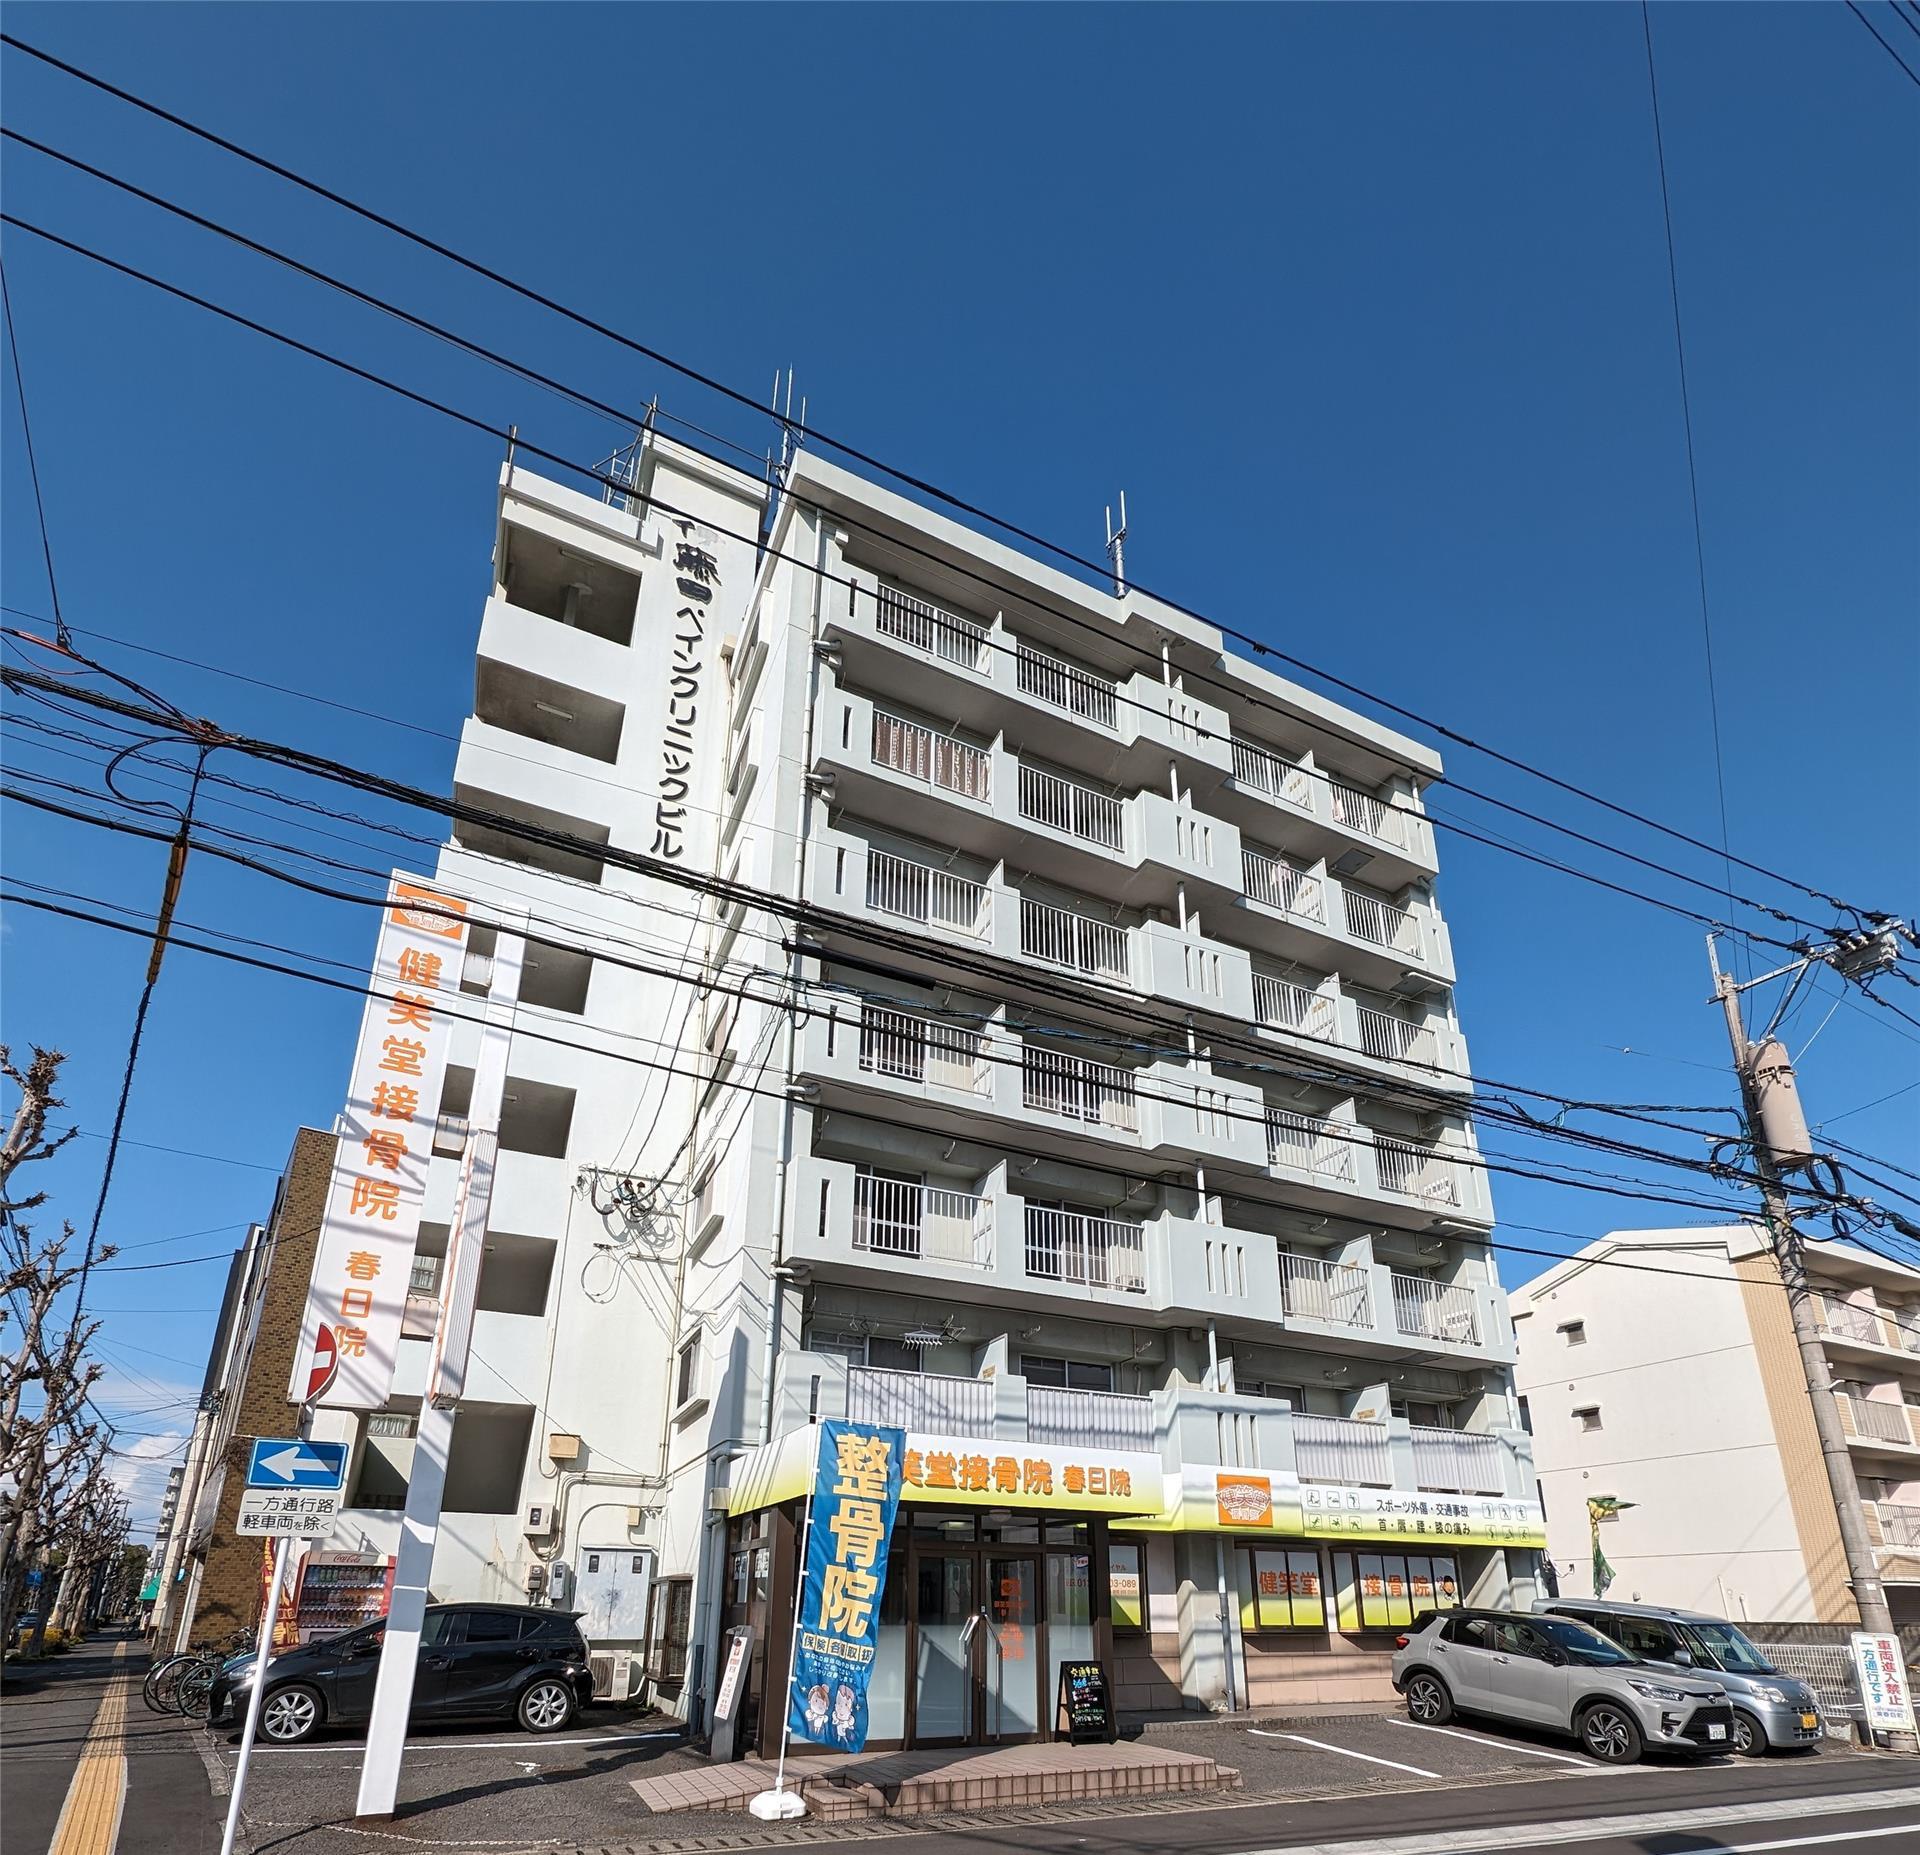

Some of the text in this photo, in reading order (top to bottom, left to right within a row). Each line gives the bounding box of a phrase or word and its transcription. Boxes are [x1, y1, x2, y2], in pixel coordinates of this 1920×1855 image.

[349, 946, 443, 1221] 健笑堂接骨院
[334, 1251, 382, 1357] 春日院
[246, 1496, 334, 1513] 一方通行路
[1063, 1464, 1132, 1497] 春日院
[242, 1514, 330, 1531] 軽車両を除く
[819, 1433, 891, 1638] 整骨院
[1259, 1571, 1431, 1598] 健笑堂 接骨院
[1860, 1641, 1883, 1703] 一方通行です
[1877, 1640, 1904, 1706] 車両進入禁止
